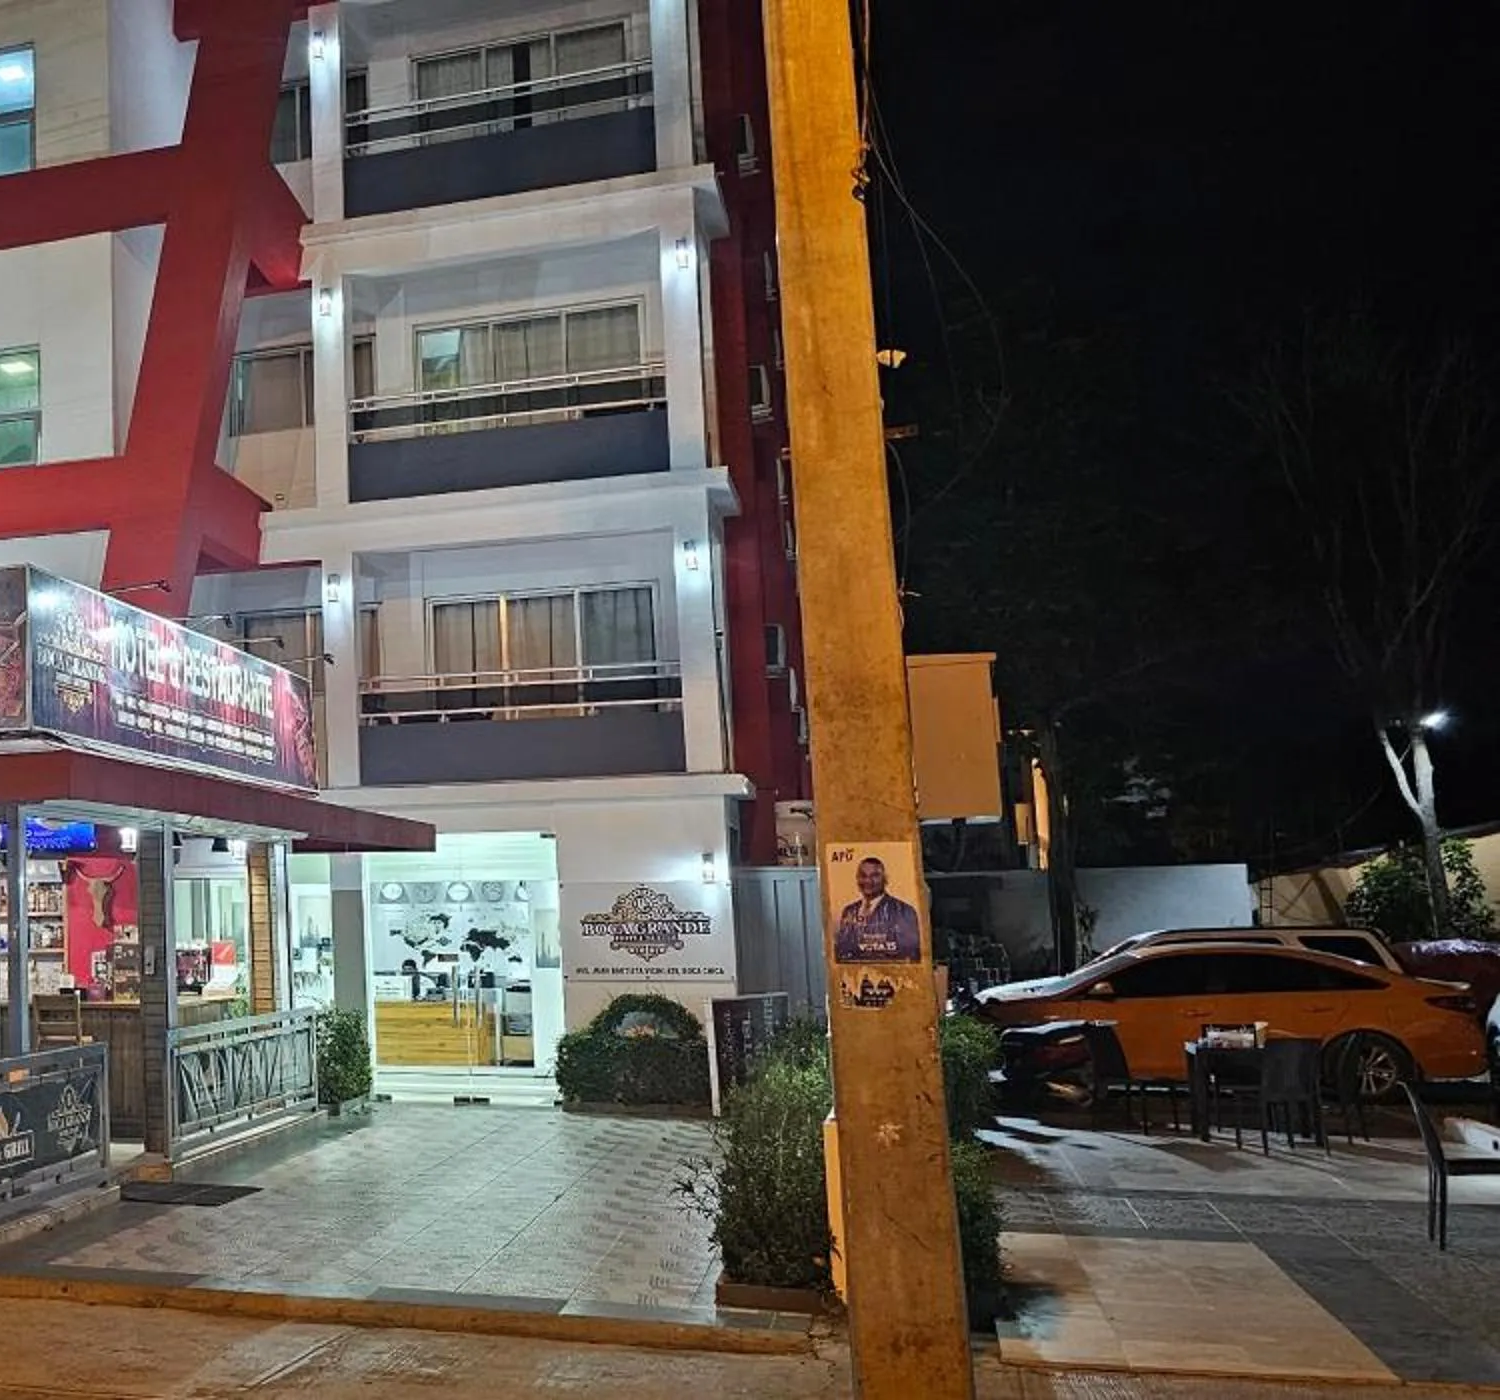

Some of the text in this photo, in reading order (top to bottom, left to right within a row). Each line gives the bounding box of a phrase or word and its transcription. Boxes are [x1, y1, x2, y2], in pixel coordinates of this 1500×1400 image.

[111, 620, 165, 682] HOTEL
[184, 645, 275, 719] RESTAURANTE
[583, 920, 711, 935] BOCA GRANDE
